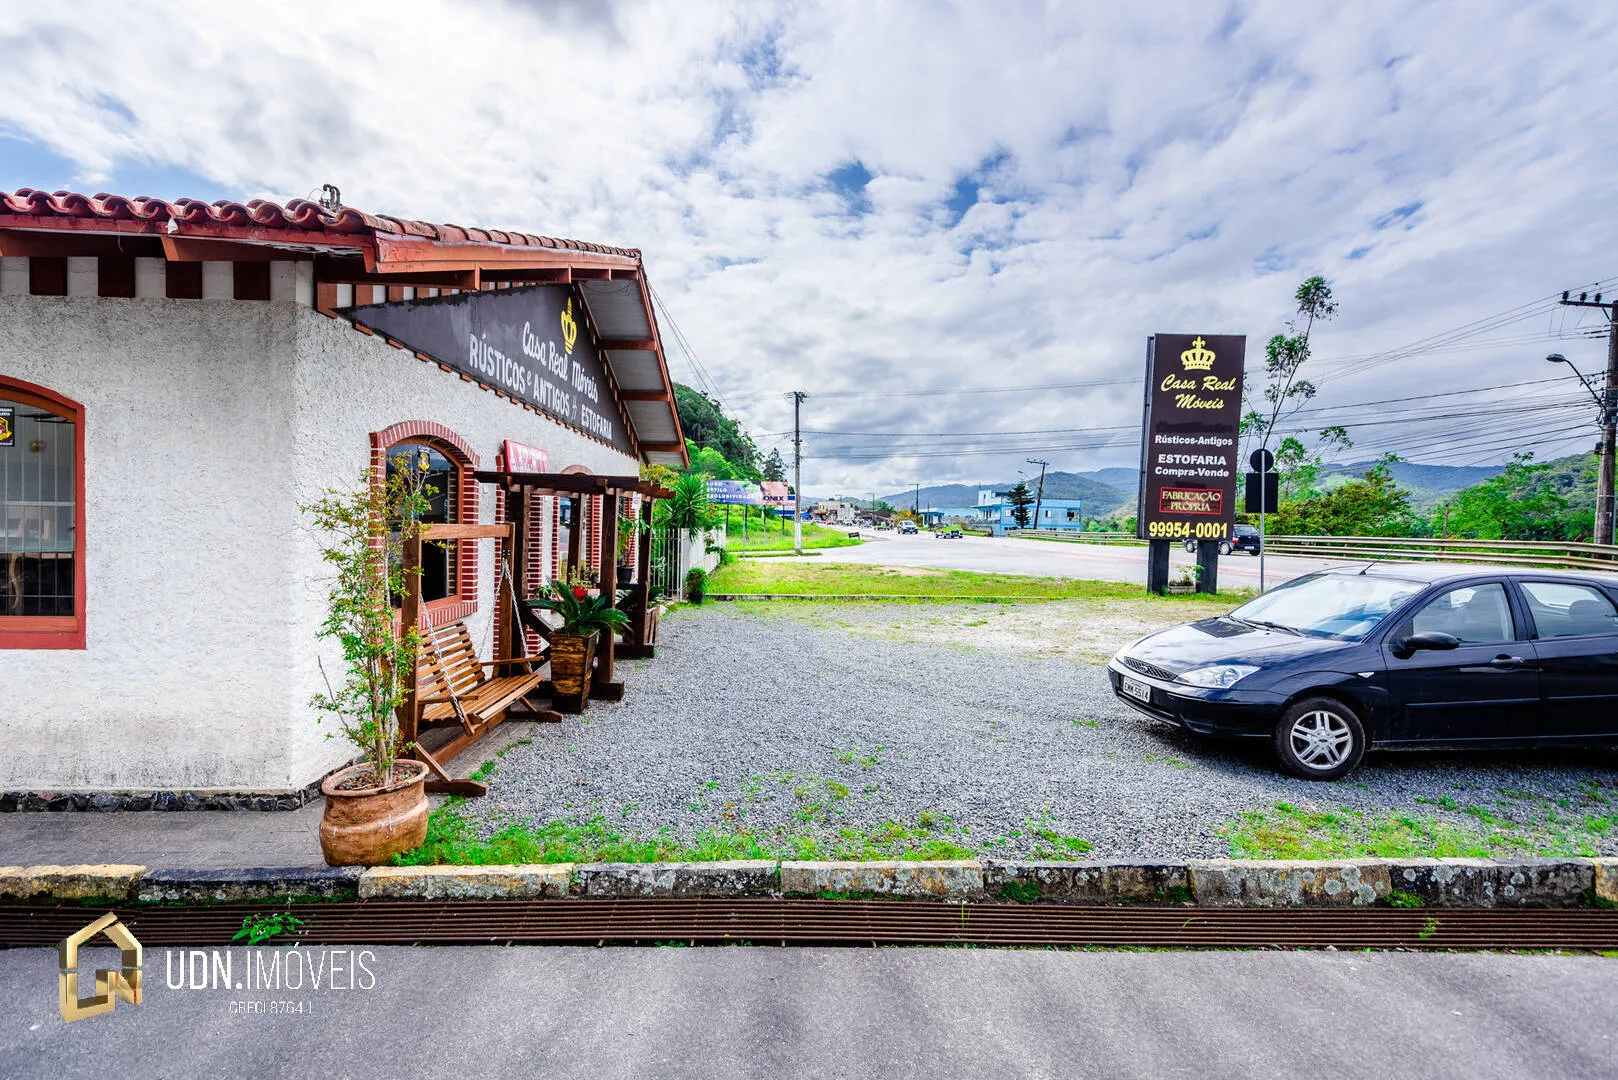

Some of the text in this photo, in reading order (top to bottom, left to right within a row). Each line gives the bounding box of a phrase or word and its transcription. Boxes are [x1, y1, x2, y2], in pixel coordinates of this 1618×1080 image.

[522, 321, 599, 403] Casa Real Móveis
[469, 333, 526, 394] RÚSTICOS
[533, 374, 570, 417] ANTIGOS
[581, 404, 612, 441] ESTOFARIA
[1161, 373, 1237, 392] Casa Real
[1175, 393, 1224, 409] Móveis
[1155, 434, 1233, 447] Rústicos-Antigos
[1158, 454, 1227, 466] ESTOFARIA
[1155, 466, 1229, 477] Compra-Vende
[1162, 491, 1221, 502] FABRICAÇÃO
[1170, 500, 1211, 512] PRÓPRIA
[1149, 521, 1228, 538] 99954-0001
